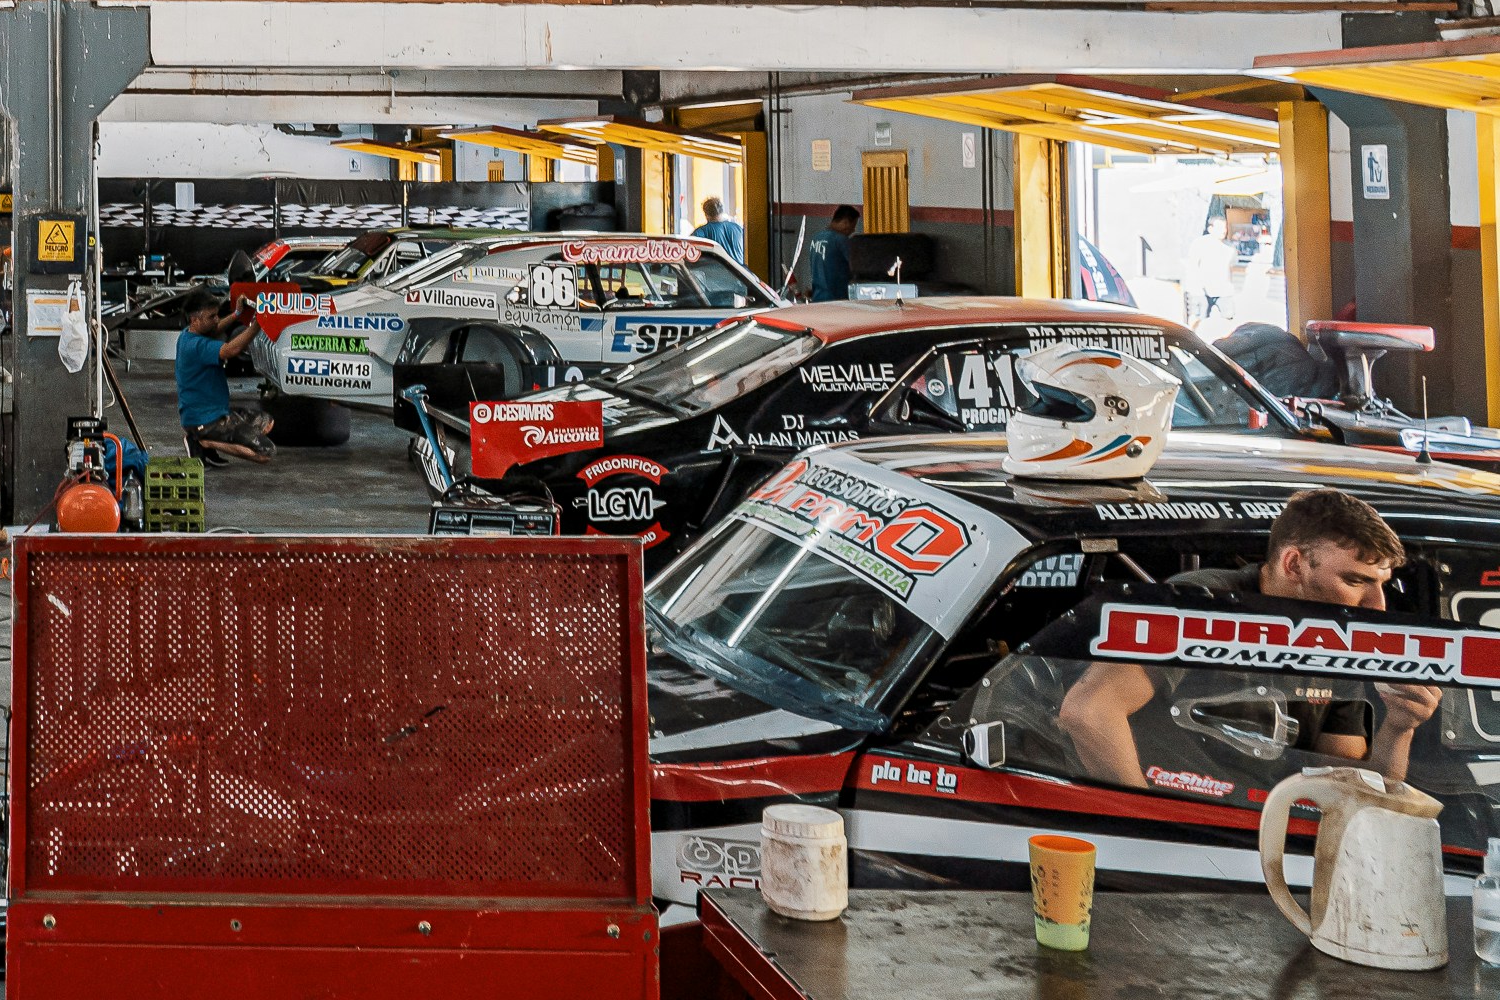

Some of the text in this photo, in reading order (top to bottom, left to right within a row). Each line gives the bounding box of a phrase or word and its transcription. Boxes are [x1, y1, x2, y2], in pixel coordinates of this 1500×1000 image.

[533, 265, 576, 307] 86
[423, 289, 495, 308] Villanueva
[318, 315, 404, 331] MILENIO
[292, 336, 369, 353] ECOTERRA S.A.
[1109, 328, 1170, 360] DANIEL
[291, 359, 329, 375] YPF
[800, 363, 895, 384] MELVILLE
[285, 376, 371, 389] HURLINGHAM
[812, 382, 890, 392] MULTIMARCA
[959, 355, 1016, 408] 41
[493, 404, 554, 421] ACESTAMPAS
[782, 415, 805, 430] DJ
[543, 429, 600, 444] Ancona
[748, 430, 860, 446] ALAN MATIAS
[585, 457, 661, 480] FRIGORIFICO
[588, 487, 654, 521] LGM
[1096, 501, 1220, 521] ALEJANDRO
[1222, 502, 1243, 520] F.
[1097, 610, 1500, 680] DURANT
[1183, 644, 1456, 676] COMPETICION
[1146, 766, 1235, 794] CarShine
